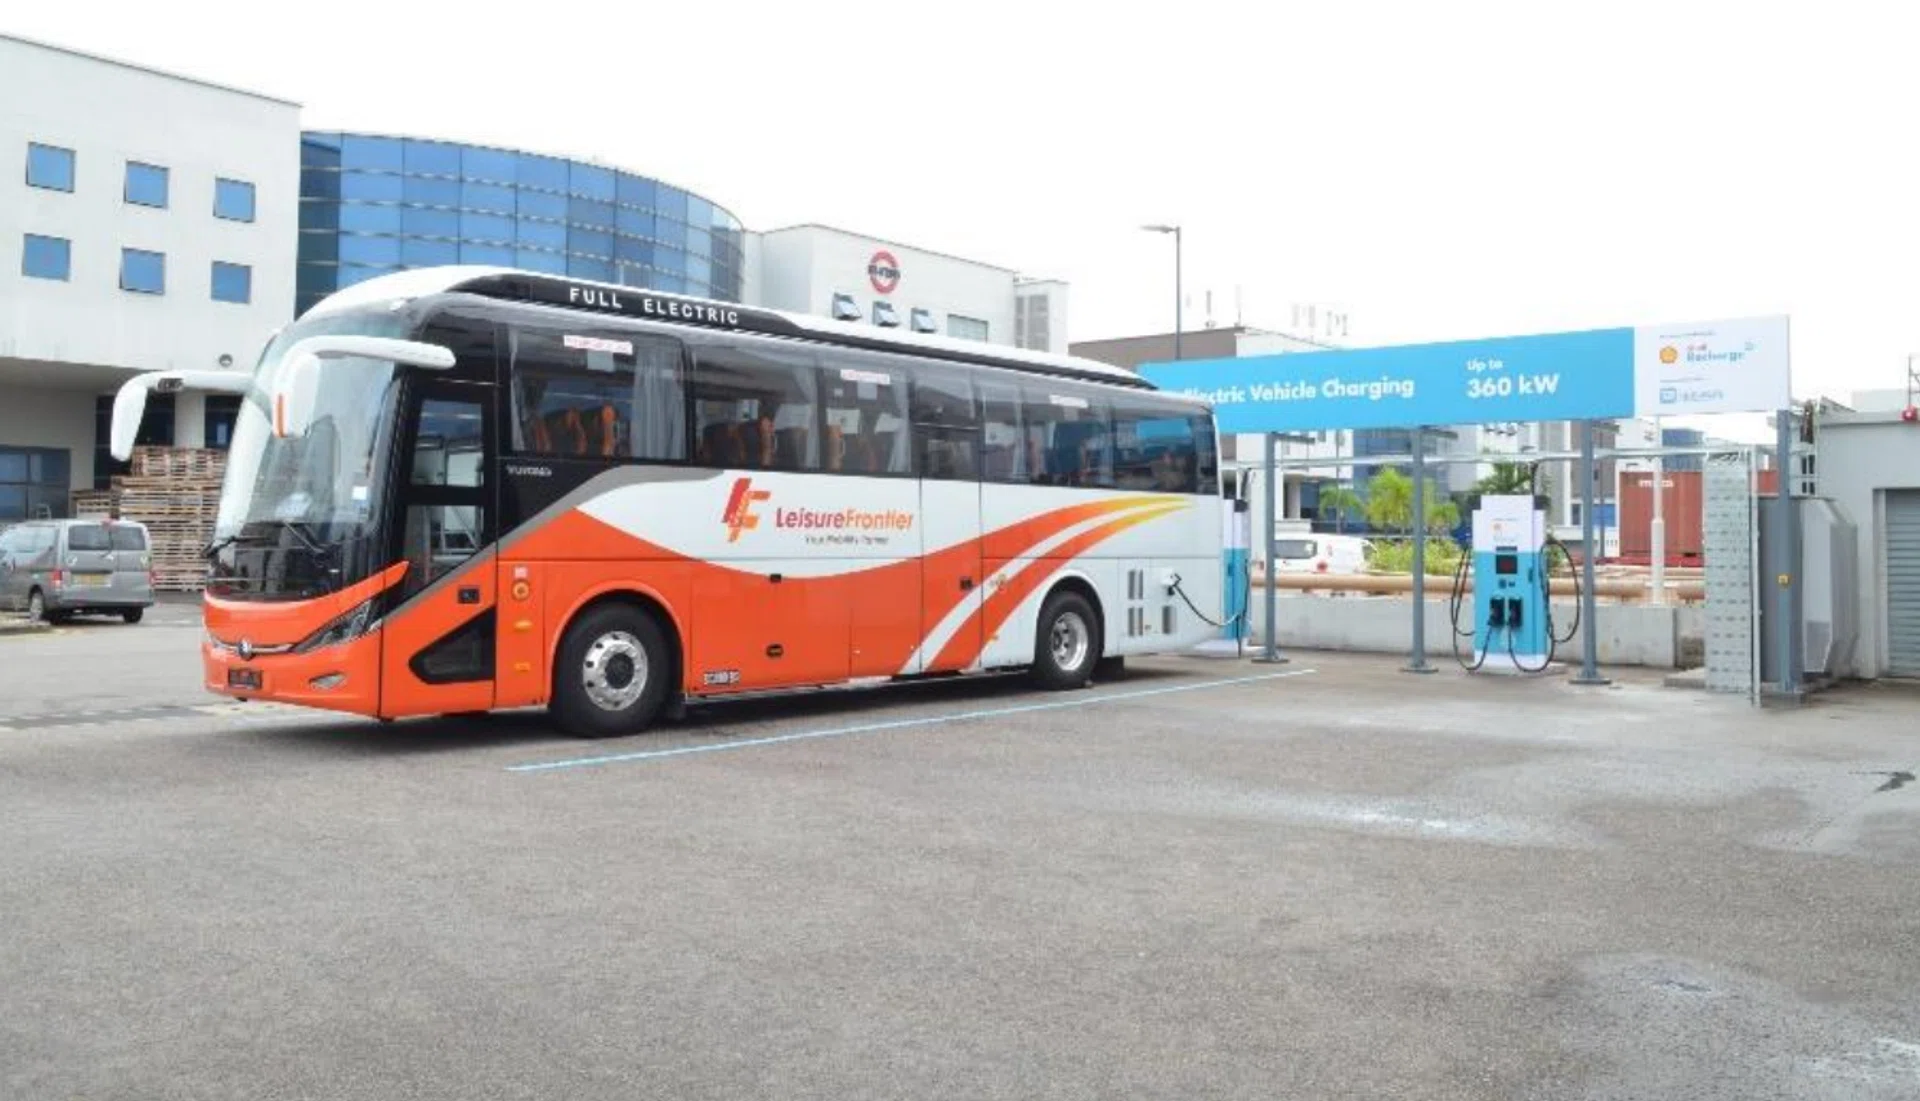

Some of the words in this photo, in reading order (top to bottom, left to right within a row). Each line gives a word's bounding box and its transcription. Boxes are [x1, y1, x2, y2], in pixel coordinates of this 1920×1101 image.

[569, 287, 623, 309] FULL
[643, 298, 738, 325] ELECTRIC
[1465, 360, 1486, 374] Up
[1488, 359, 1503, 370] to
[1250, 379, 1317, 402] Vehicle
[1321, 376, 1415, 400] Charging
[1467, 376, 1511, 399] 360
[1518, 373, 1560, 395] kW
[775, 507, 914, 530] LeisureFrontier
